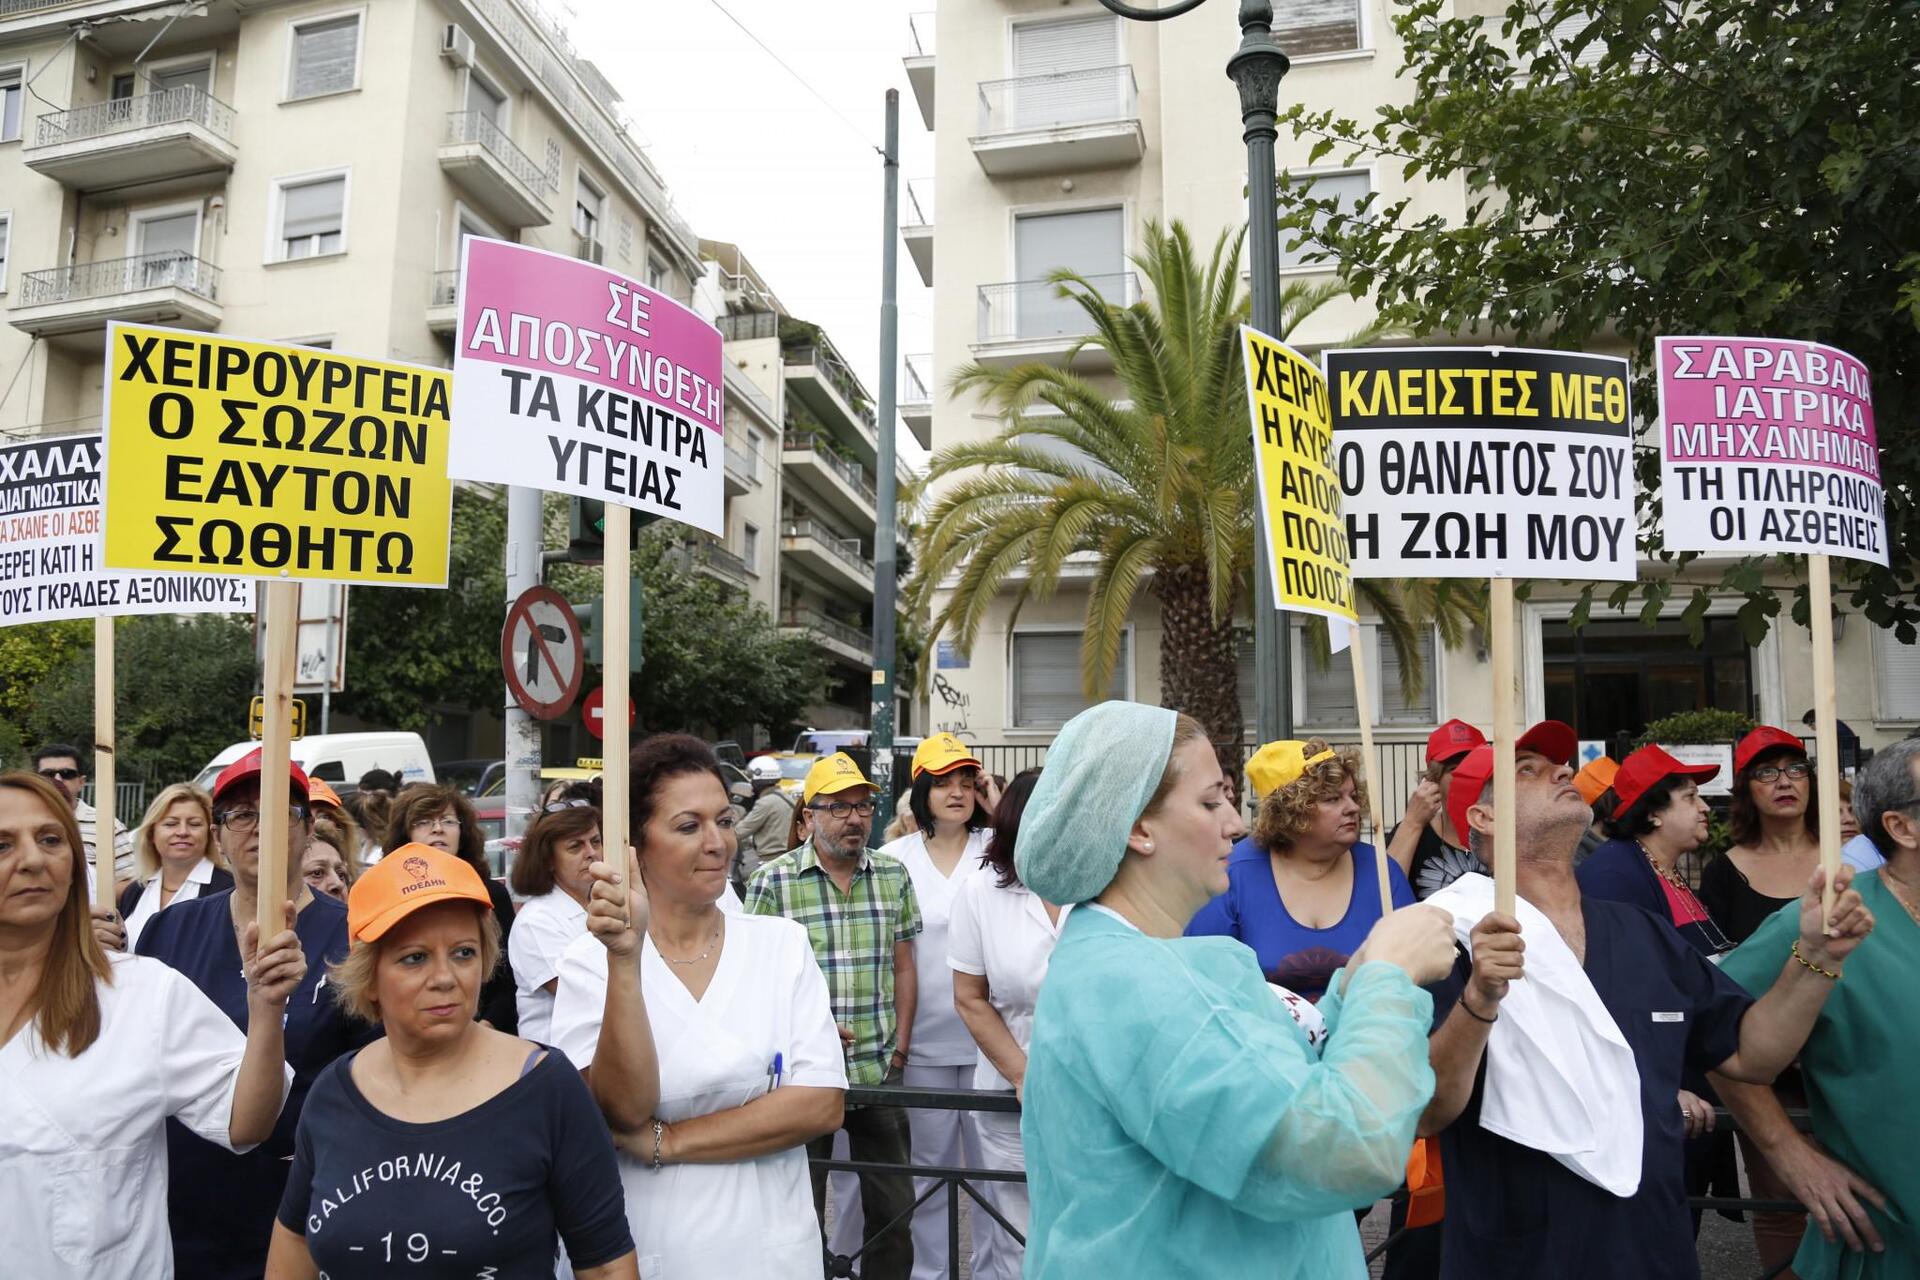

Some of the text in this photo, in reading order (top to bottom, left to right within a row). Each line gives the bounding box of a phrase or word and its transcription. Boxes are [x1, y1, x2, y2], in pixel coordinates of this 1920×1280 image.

[120, 334, 450, 421] ΧΕΙΡΟΥΡΓΕΙΑ
[469, 307, 720, 426] ΑΠΟΣΥΝΘΕΣΗ
[1672, 346, 1872, 407] ΣΑΡΑΒΑΛΑ
[502, 369, 708, 469] ΤΑ ΚΕΝΤΡΑ
[1339, 369, 1626, 424] ΚΛΕΙΣΤΕΣ ΜΕΘ
[1714, 385, 1866, 436] ΙΑΤΡΙΚΑ
[149, 393, 428, 465] Ο ΣΩΖΩΝ
[1261, 403, 1283, 447] Η
[1672, 424, 1880, 478] ΜΗΧΑΝΗΜΑΤΑ
[165, 455, 410, 519] ΕΑΥΤΟΝ
[547, 435, 681, 511] ΥΓΕΙΑΣ
[1339, 440, 1625, 500] Ο ΘΑΝΑΤΟΣ ΣΟΥ
[1674, 467, 1885, 520] ΤΗ ΠΛΗΡΩΝΟΥΝ
[0, 520, 7, 542] Α
[11, 514, 48, 542] ΣΚΑΝΕ
[53, 512, 64, 537] ΟΙ
[153, 515, 413, 575] ΣΩΘΗΤΩ
[1282, 511, 1350, 568] ΠΟΙΟΣ
[1346, 512, 1625, 562] Η ΖΩΗ ΜΟΥ
[1710, 506, 1880, 554] ΟΙ ΑΣΘΕΝΕΙΣ
[41, 545, 75, 575] ΚΑΤΙ
[82, 543, 93, 571] Η
[1282, 557, 1346, 607] ΠΟΙΟΣ
[0, 576, 247, 616] ΟΥΣ ΓΚΡΑΔΕΣ ΑΞΟΝΙΚΟΥΣ;
